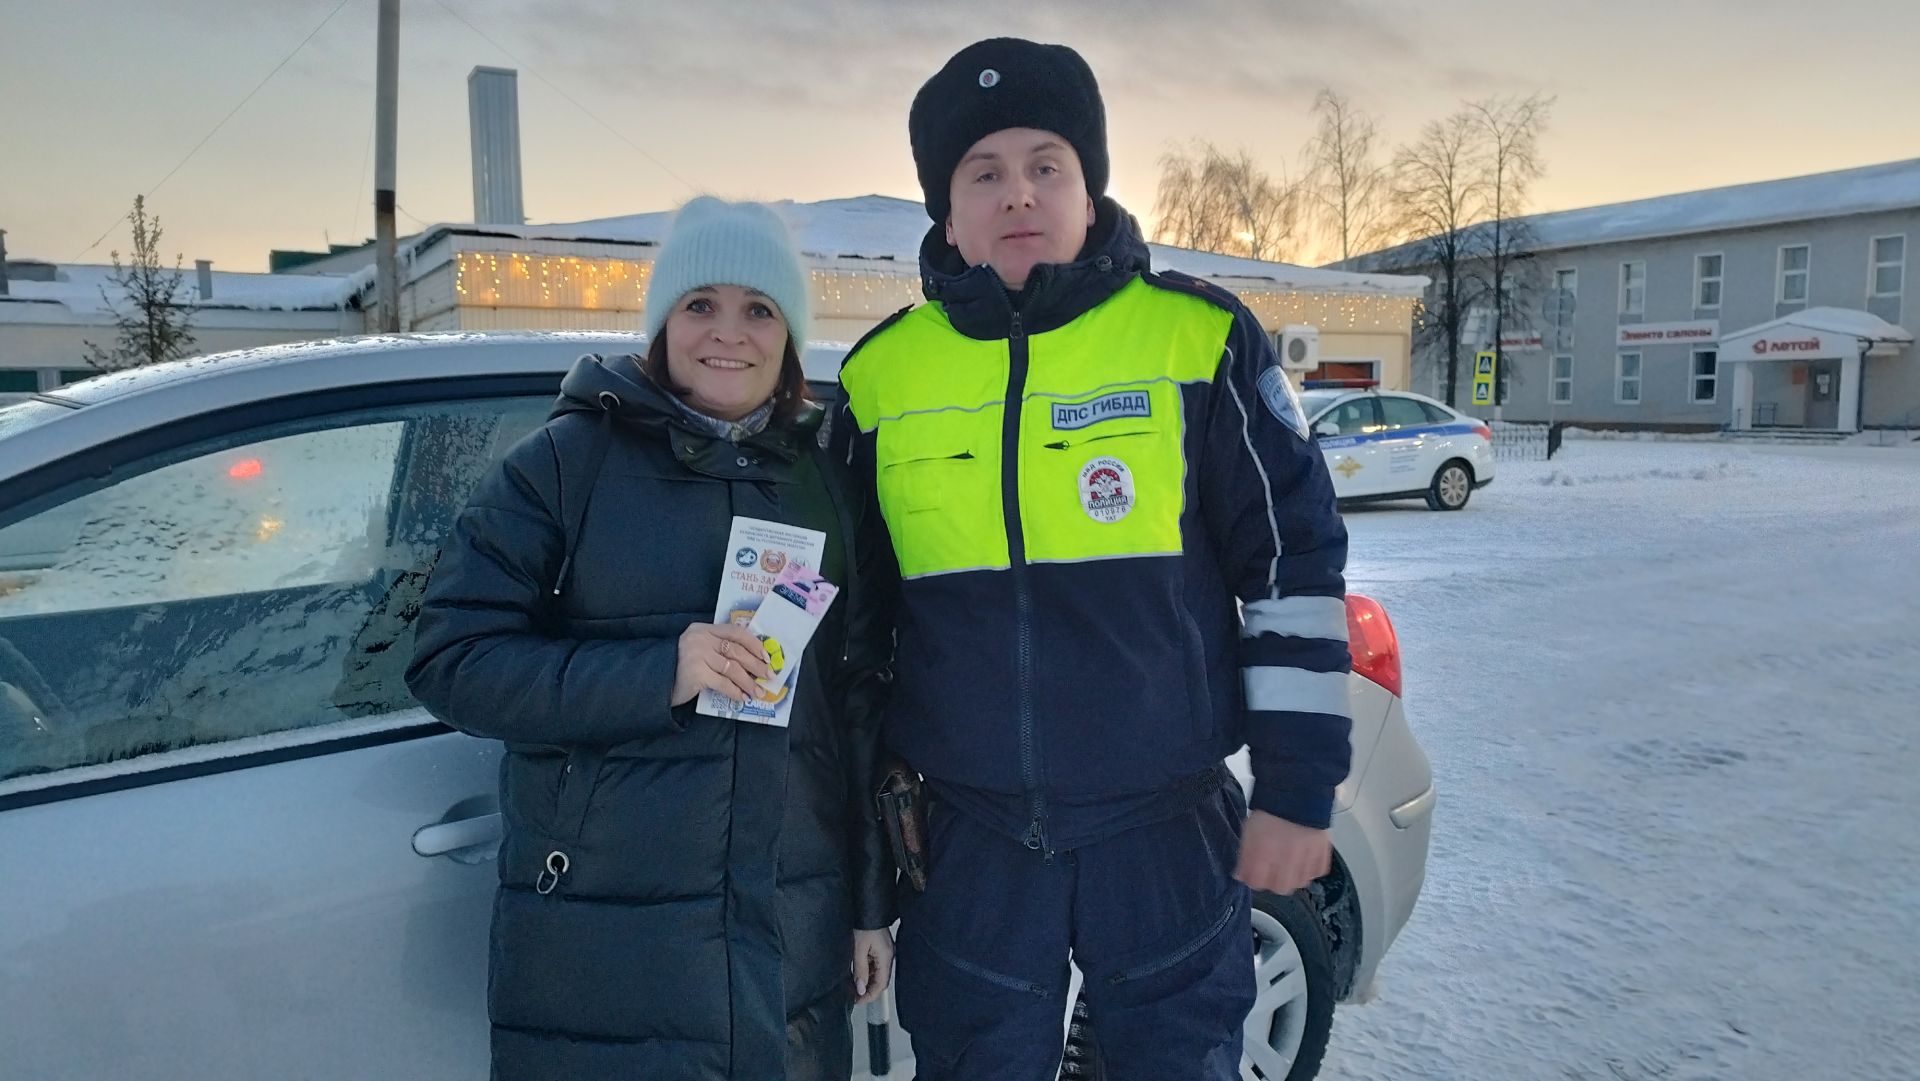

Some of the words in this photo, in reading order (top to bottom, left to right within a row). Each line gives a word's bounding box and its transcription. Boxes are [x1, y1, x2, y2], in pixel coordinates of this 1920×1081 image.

[1057, 407, 1088, 424] ДПС
[1092, 396, 1146, 415] ГИБДД
[730, 570, 759, 582] СТАНЬ
[741, 582, 754, 593] НА
